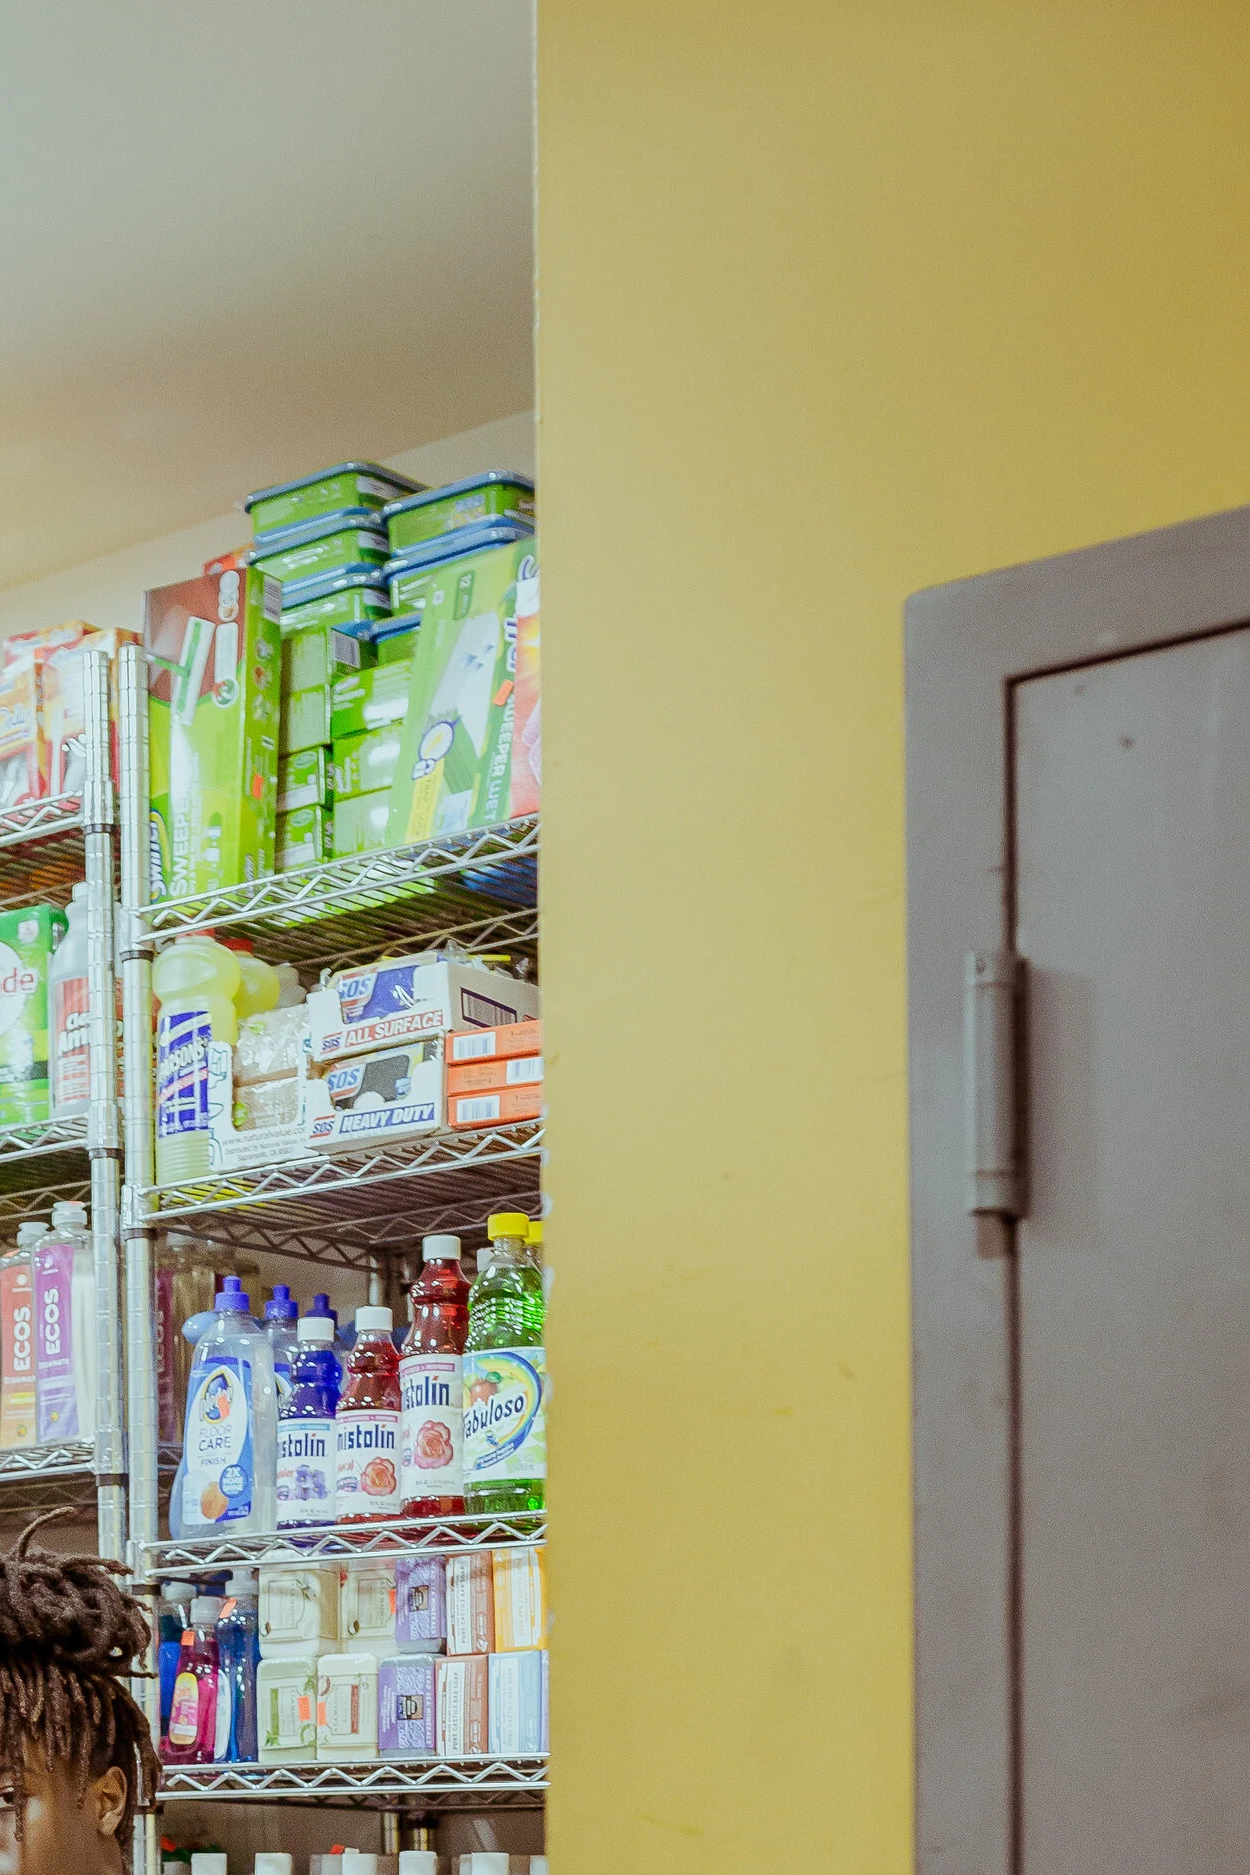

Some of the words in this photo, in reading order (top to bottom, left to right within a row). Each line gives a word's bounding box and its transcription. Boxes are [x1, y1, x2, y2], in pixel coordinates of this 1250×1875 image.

[345, 1030, 372, 1047] ALL
[374, 1011, 443, 1039] SURFACE
[327, 1068, 360, 1091] SOS
[313, 1121, 335, 1134] SOS
[341, 1111, 389, 1134] HEAVY
[391, 1103, 435, 1124] DUTY
[13, 1305, 31, 1371] ECOS
[38, 1288, 61, 1355] ECOS
[464, 1395, 524, 1439] abuloso
[198, 1436, 232, 1452] CARE
